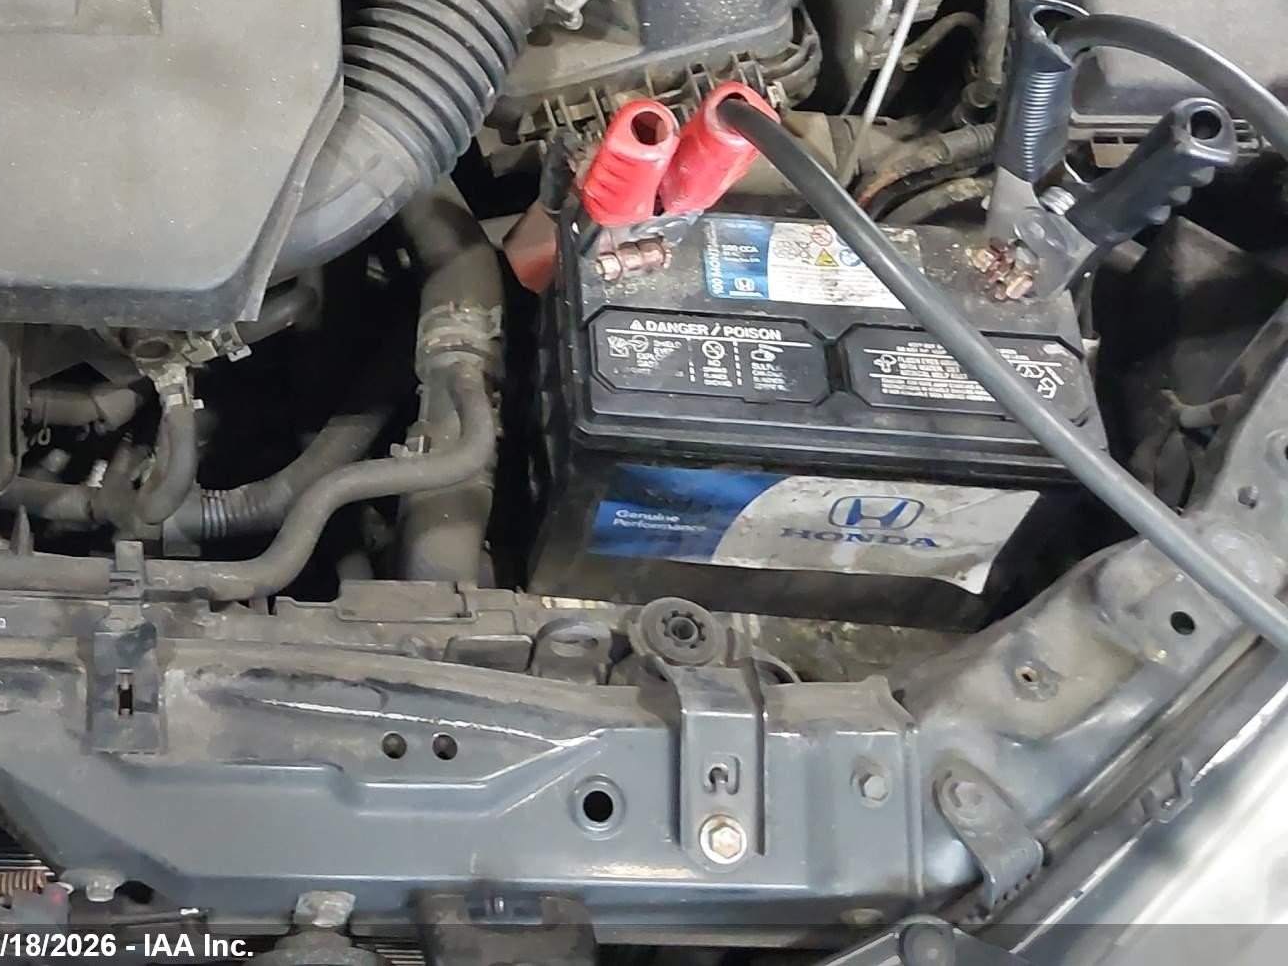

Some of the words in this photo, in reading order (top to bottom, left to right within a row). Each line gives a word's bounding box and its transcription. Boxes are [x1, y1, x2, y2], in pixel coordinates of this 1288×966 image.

[645, 320, 710, 336] DANGER
[723, 325, 782, 341] POISON
[615, 509, 681, 523] Genuine
[613, 518, 708, 533] Performance
[780, 526, 941, 549] HONDA
